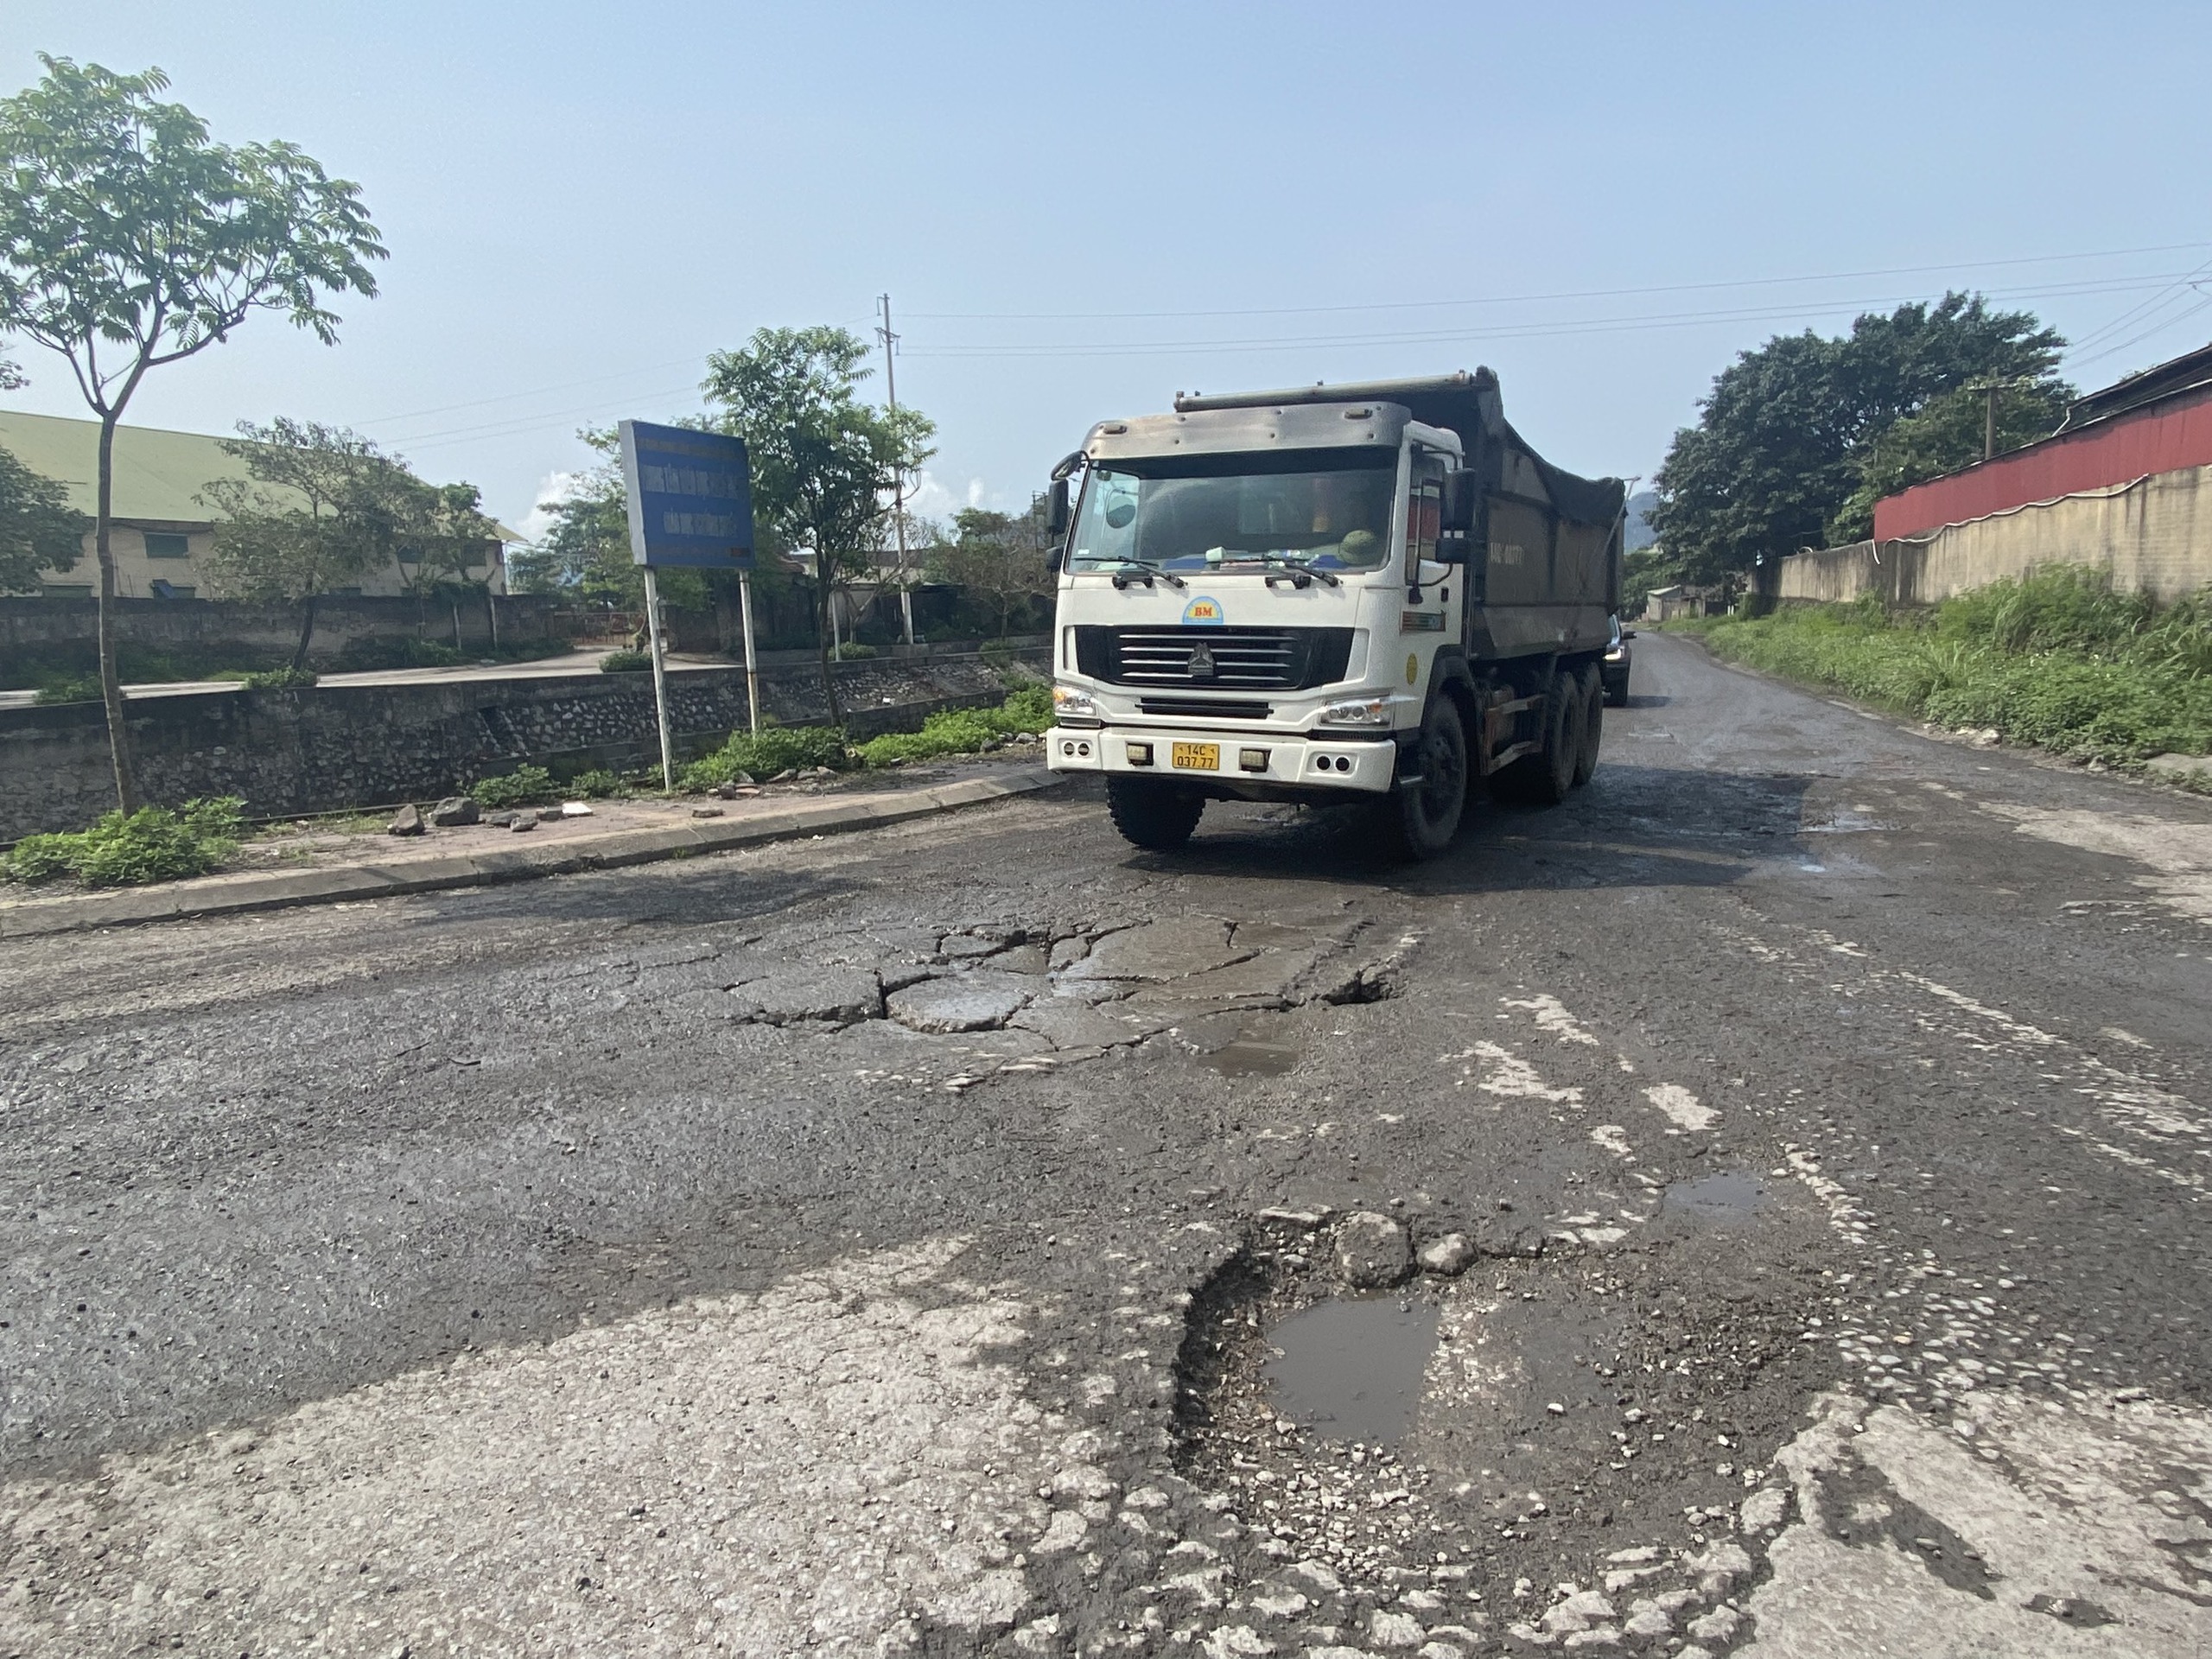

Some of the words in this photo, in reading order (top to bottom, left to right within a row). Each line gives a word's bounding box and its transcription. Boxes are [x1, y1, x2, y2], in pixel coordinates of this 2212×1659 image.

[1194, 607, 1212, 617] BM
[1187, 744, 1206, 756] 14C
[1177, 755, 1214, 768] 037.77
